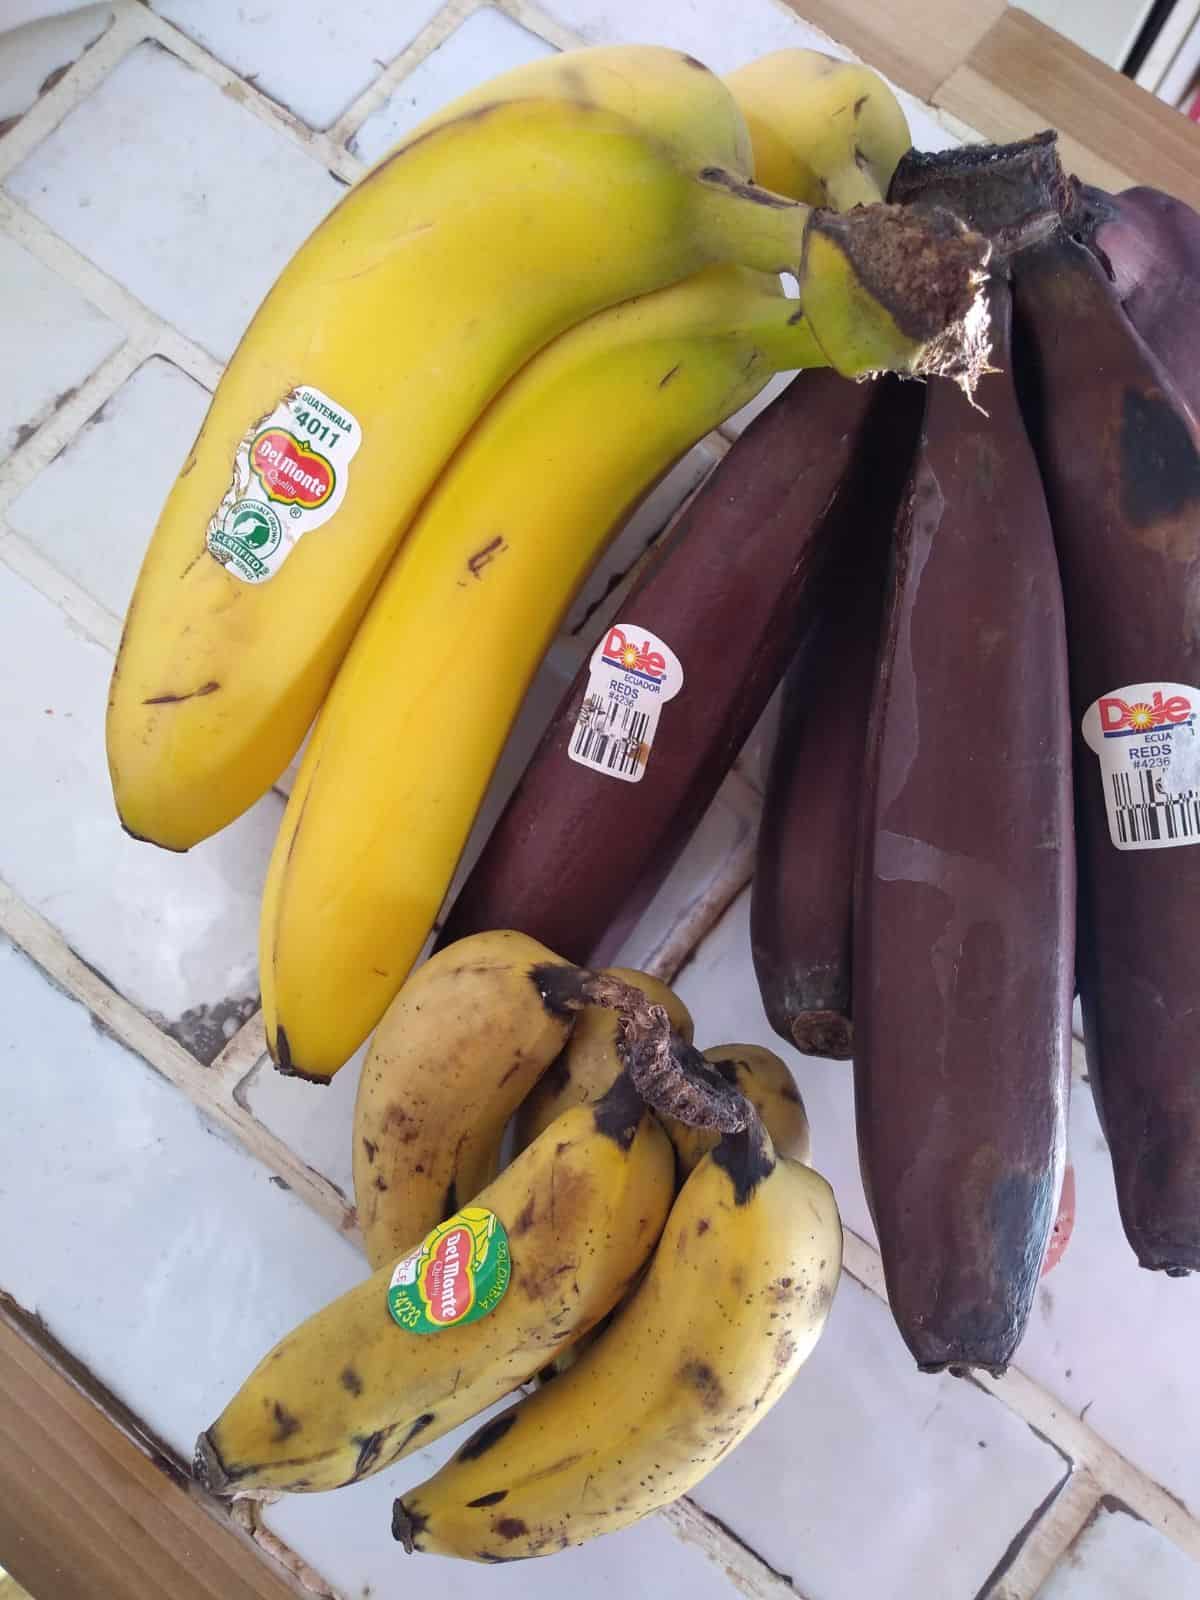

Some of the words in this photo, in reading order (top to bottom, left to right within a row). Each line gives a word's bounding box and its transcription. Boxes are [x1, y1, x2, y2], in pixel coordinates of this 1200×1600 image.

[301, 391, 353, 433] GUATEMALA
[258, 440, 284, 467] Del
[280, 456, 327, 497] Monte
[267, 468, 297, 496] Quality
[216, 533, 261, 570] CERTIFIED
[602, 626, 667, 677] Dole
[608, 691, 635, 708] #4236
[609, 679, 640, 699] REDS
[624, 673, 661, 694] ECUADOR
[1098, 689, 1192, 732] Dole
[1129, 744, 1172, 760] REDS
[1133, 757, 1171, 769] #4236
[445, 1232, 461, 1262] Del
[440, 1260, 460, 1318] Monte
[478, 1240, 508, 1310] COLOMBIA
